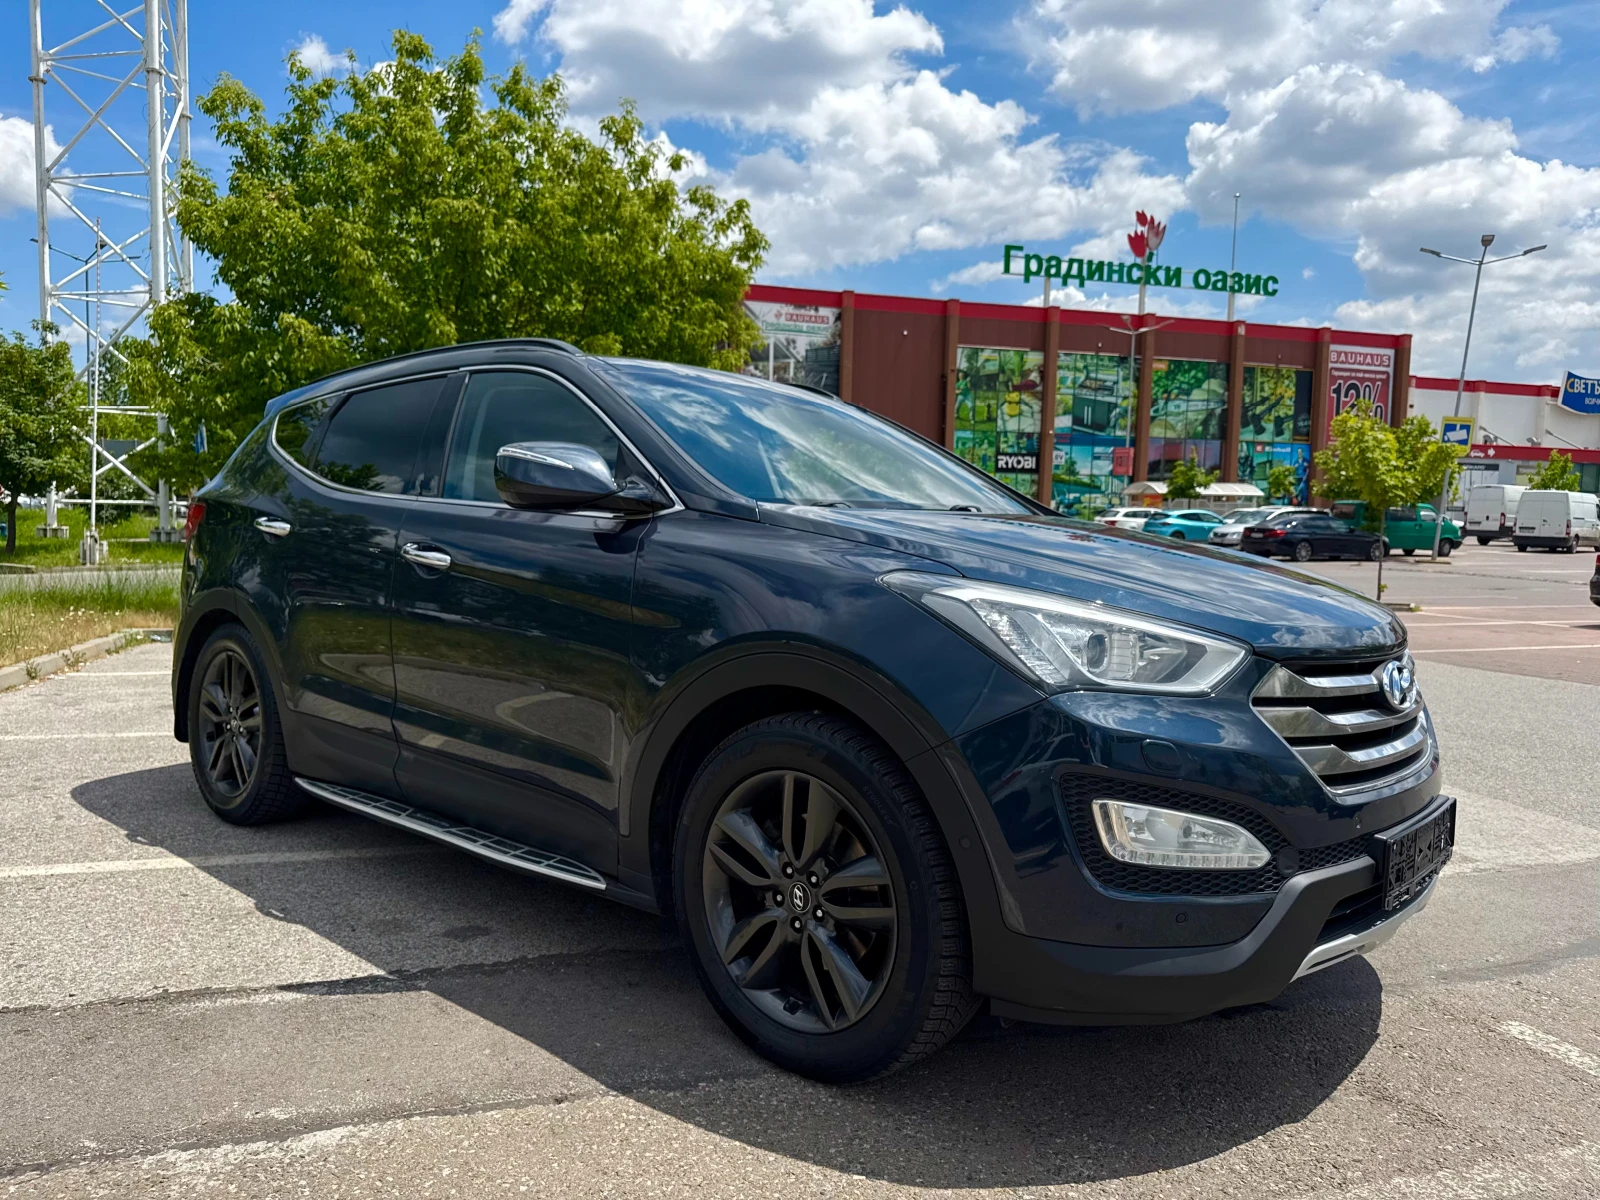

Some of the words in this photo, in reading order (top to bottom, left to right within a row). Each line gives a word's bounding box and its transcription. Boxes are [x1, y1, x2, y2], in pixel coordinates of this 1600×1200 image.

[1003, 245, 1182, 288] Градински
[1193, 268, 1279, 297] оазис
[1331, 351, 1389, 366] BAUHAUS
[1566, 378, 1600, 395] СВЕТЪ
[997, 456, 1036, 469] RYOBI
[862, 785, 893, 825] STUDLESS
